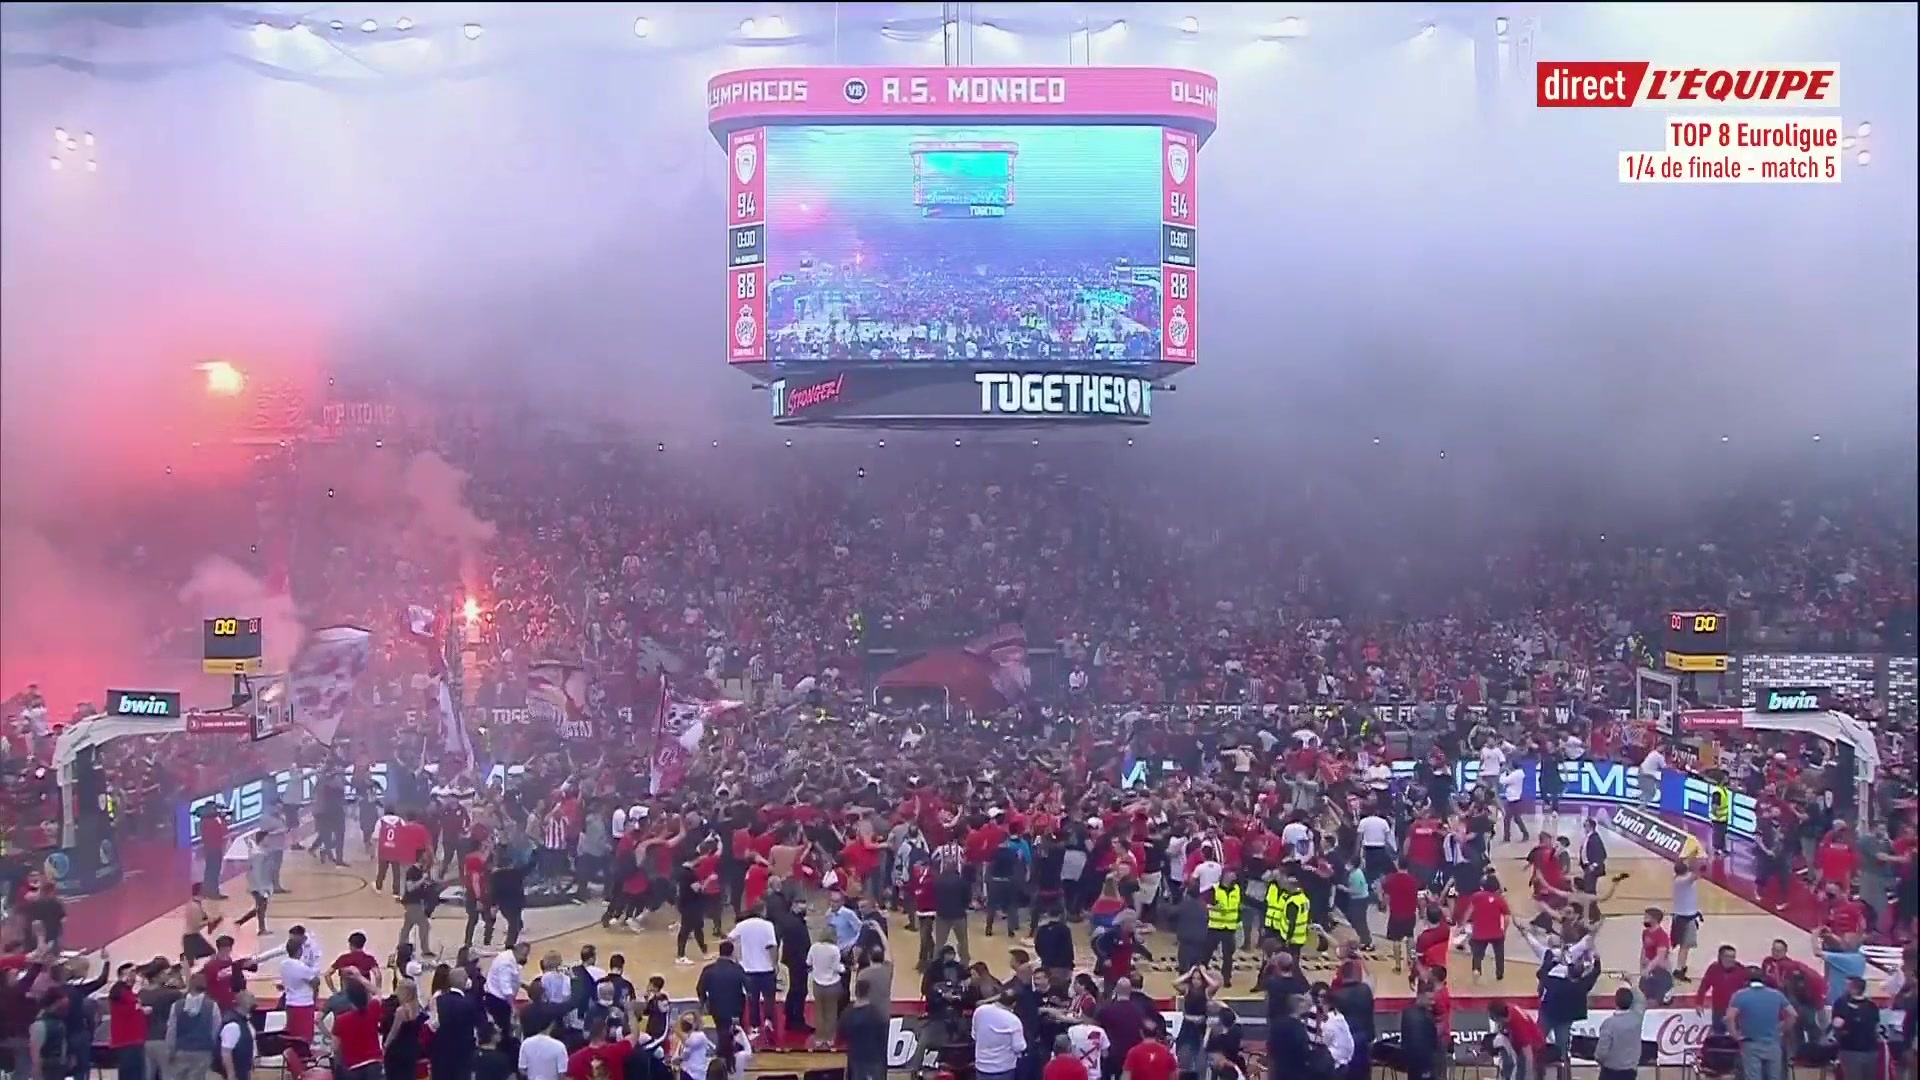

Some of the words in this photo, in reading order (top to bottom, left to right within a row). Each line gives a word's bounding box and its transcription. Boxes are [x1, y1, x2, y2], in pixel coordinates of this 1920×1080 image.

[883, 78, 935, 103] A.S.
[947, 77, 1065, 103] MONACO
[737, 192, 755, 218] 94
[1171, 192, 1188, 218] 94
[737, 273, 756, 299] 88
[1171, 273, 1188, 299] 88
[975, 373, 1126, 413] TOGETHER
